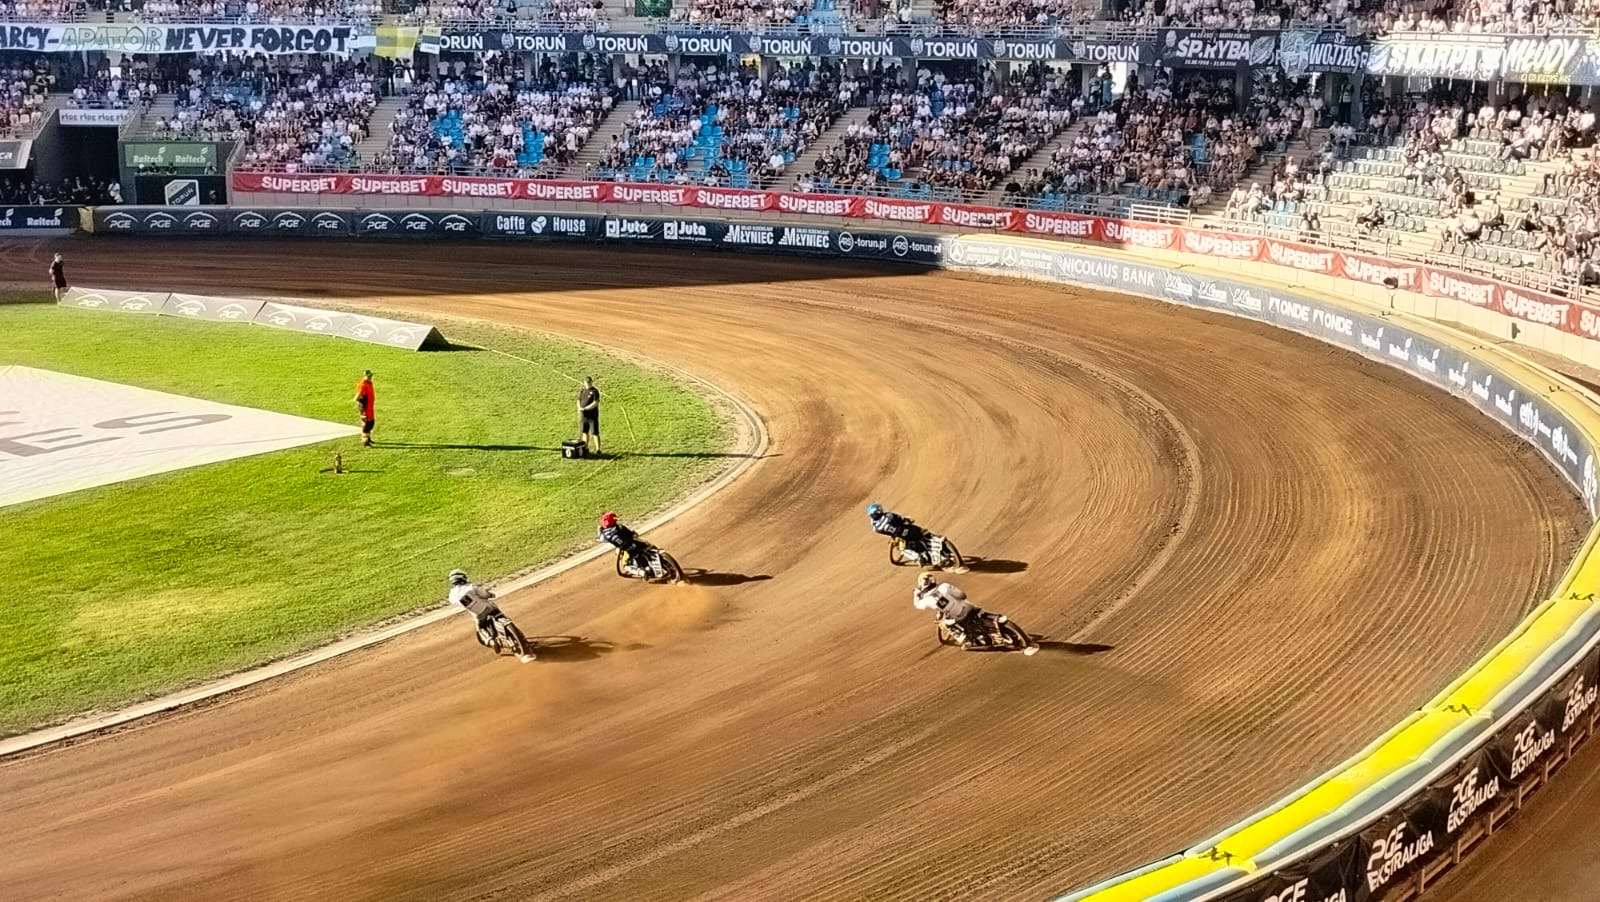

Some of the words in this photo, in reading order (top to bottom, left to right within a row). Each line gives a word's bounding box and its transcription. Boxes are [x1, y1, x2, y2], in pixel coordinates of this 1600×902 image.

[165, 27, 247, 50] NEVER
[251, 27, 351, 51] FORGOT
[440, 33, 484, 49] ORUŃ
[515, 33, 566, 50] TORUŃ
[596, 34, 648, 51] TORUŃ
[679, 35, 732, 52] TORUŃ
[763, 37, 811, 54] TORUŃ
[842, 38, 893, 55] TORUŃ
[924, 40, 978, 57] TORUŃ
[1006, 40, 1056, 58] TORUŃ
[1086, 42, 1139, 61] TORUŃ
[1309, 43, 1362, 73] WOJTAS
[27, 216, 60, 226] Raitech
[110, 220, 131, 228] PGE
[150, 220, 172, 228] PGE
[190, 220, 210, 228] PGE
[240, 219, 260, 228] PGE
[278, 219, 300, 228] PGE
[318, 220, 338, 229] PGE
[367, 220, 388, 230] PGE
[406, 221, 427, 230] PGE
[445, 222, 466, 231] PGE
[496, 215, 525, 230] Caffe
[553, 216, 586, 232] House
[620, 218, 648, 233] Juta
[678, 220, 706, 236] Juta
[728, 224, 774, 244] MŁYNIEC
[262, 176, 337, 192] SUPERBET
[351, 177, 428, 194] SUPERBET
[442, 180, 514, 196] SUPERBET
[527, 182, 600, 200] SUPERBET
[613, 186, 684, 203] SUPERBET
[697, 190, 767, 208] SUPERBET
[779, 195, 851, 214] SUPERBET
[864, 200, 930, 220] SUPERBET
[1026, 213, 1094, 235] SUPERBET
[1106, 222, 1174, 247] SUPERBET
[1185, 231, 1260, 257] SUPERBET
[1270, 242, 1334, 270] SUPERBET
[1430, 272, 1495, 304] SUPERBET
[1504, 290, 1570, 325] SUPERBET
[784, 227, 830, 248] MŁYNIEC
[1062, 256, 1118, 280] NICOLAUS
[1122, 266, 1155, 286] BANK
[1510, 728, 1555, 780] EKSTRALIGA
[1512, 720, 1536, 760] PGE
[1447, 776, 1500, 833] EKSTRALIGA
[1449, 768, 1478, 812] PGE
[1367, 822, 1407, 870] PGE
[1366, 830, 1434, 894] EKSTRALIGA
